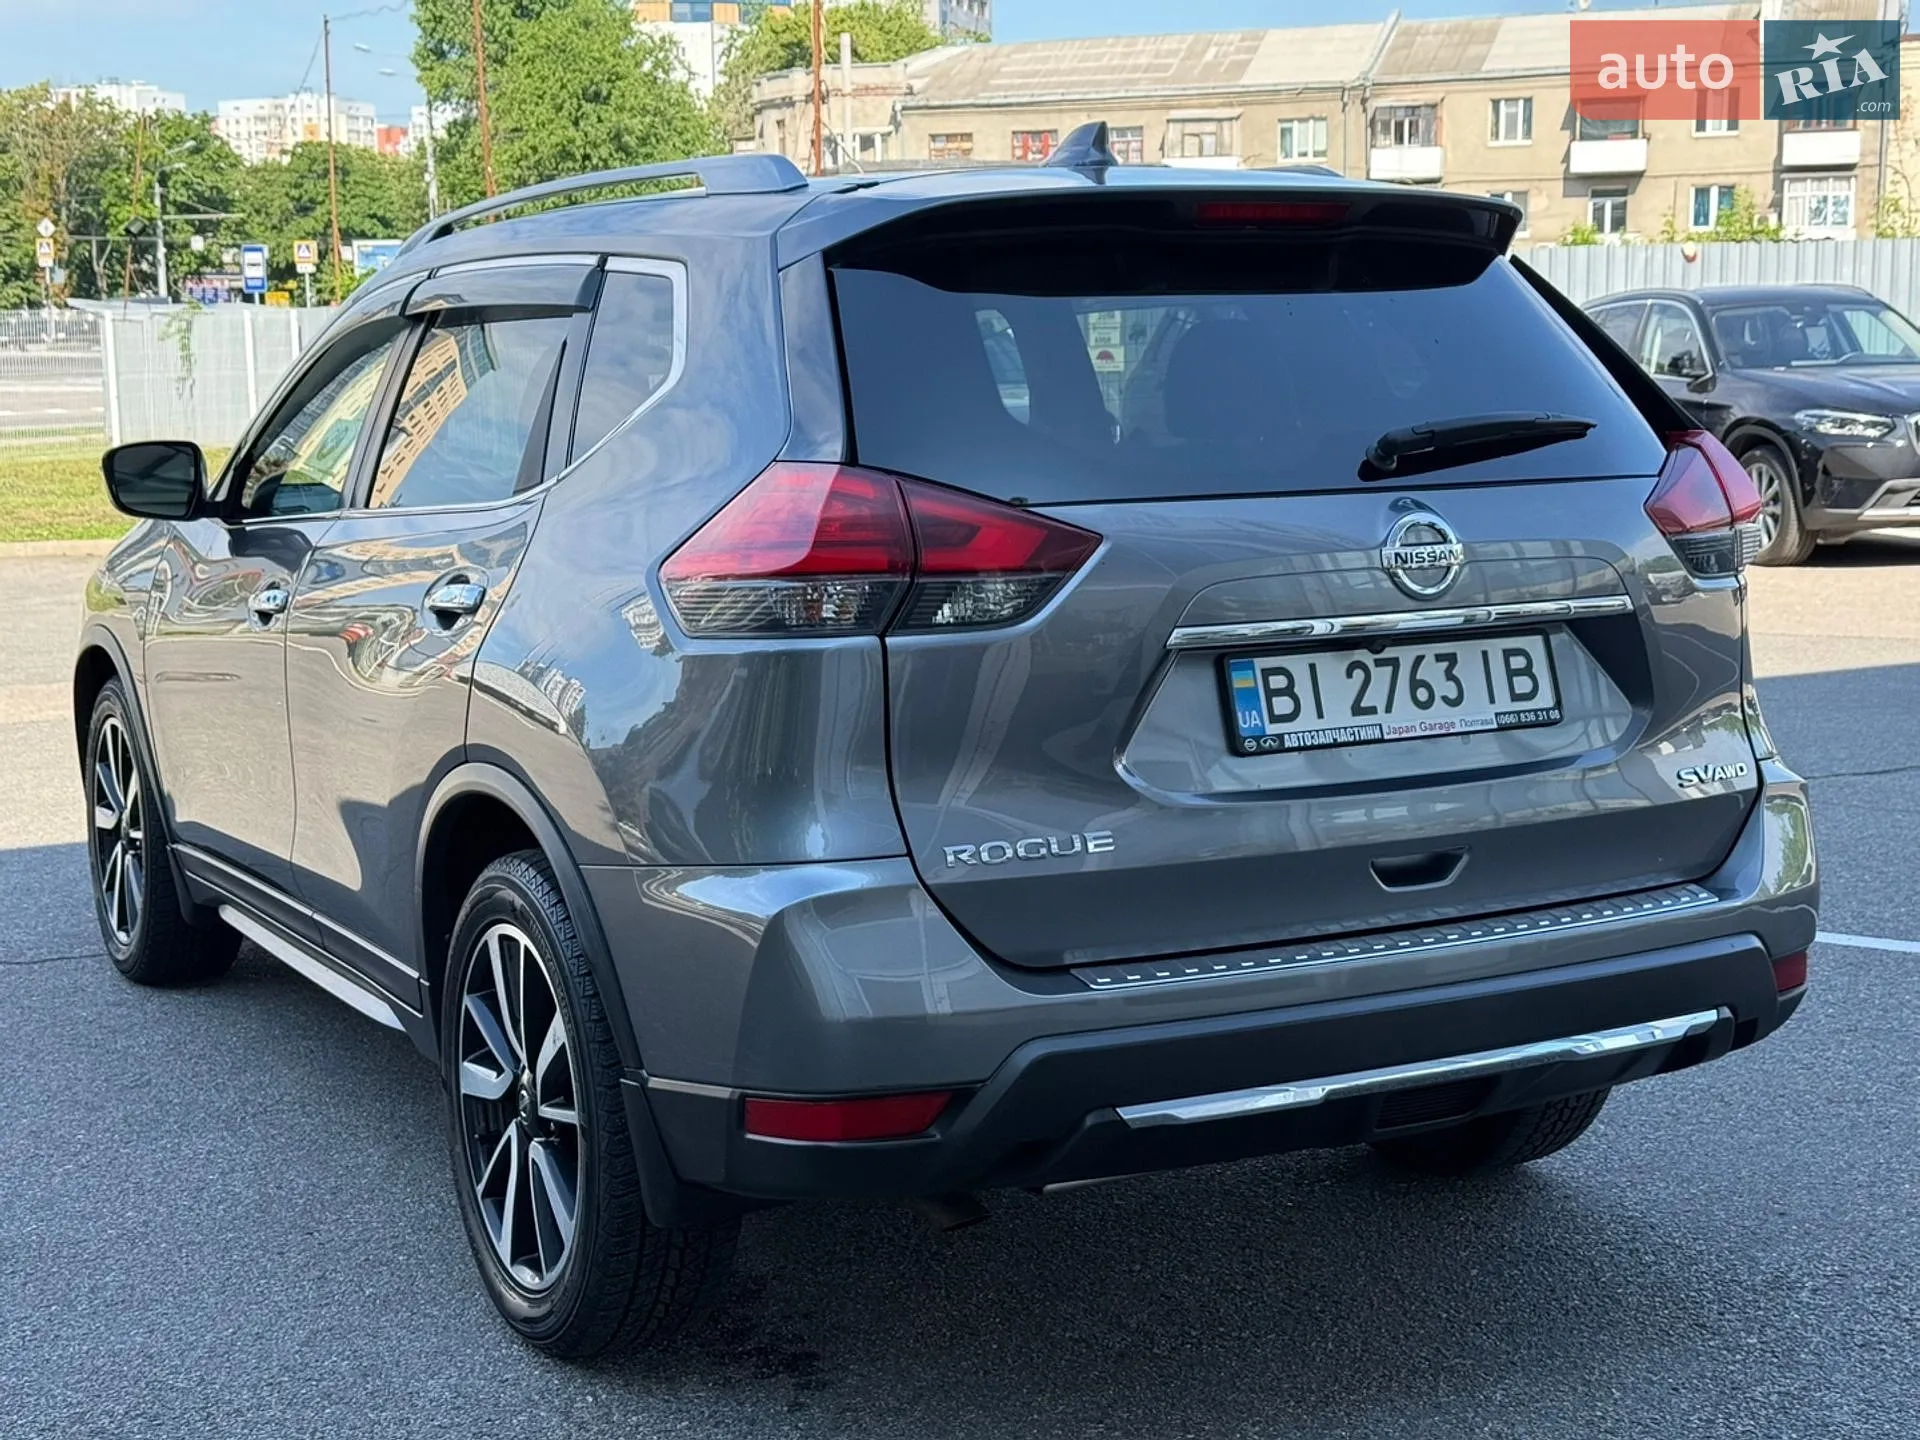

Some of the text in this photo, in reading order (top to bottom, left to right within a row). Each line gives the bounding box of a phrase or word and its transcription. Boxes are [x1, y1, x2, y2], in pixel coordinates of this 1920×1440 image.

[1394, 549, 1459, 565] NISSAN
[1261, 647, 1540, 724] BI 2763 IB
[1238, 710, 1262, 728] UA
[1283, 724, 1382, 748] АВТОЗАПЧАСТИНИ
[1386, 724, 1417, 736] Japan
[1419, 720, 1456, 733] Garage
[942, 830, 1116, 868] ROGUE
